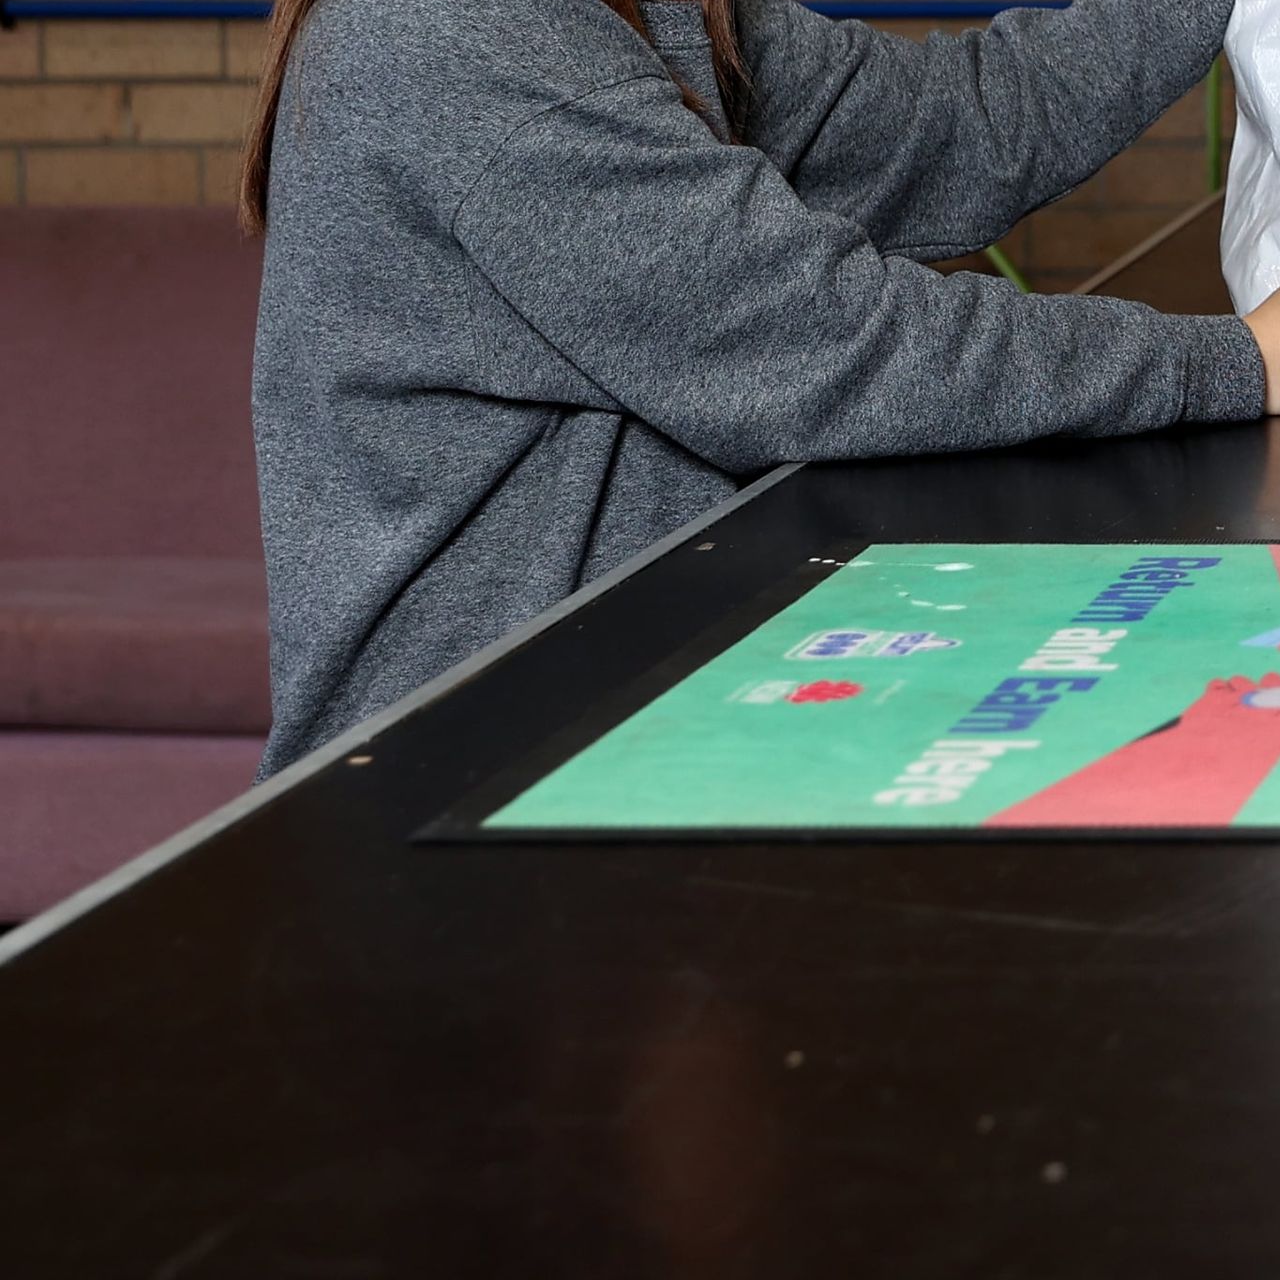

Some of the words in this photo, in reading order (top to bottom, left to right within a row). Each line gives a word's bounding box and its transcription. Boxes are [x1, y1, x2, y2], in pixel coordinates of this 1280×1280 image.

[1070, 557, 1223, 623] Return
[1017, 627, 1128, 671] and
[948, 677, 1100, 733] Earn
[873, 739, 1041, 807] here
